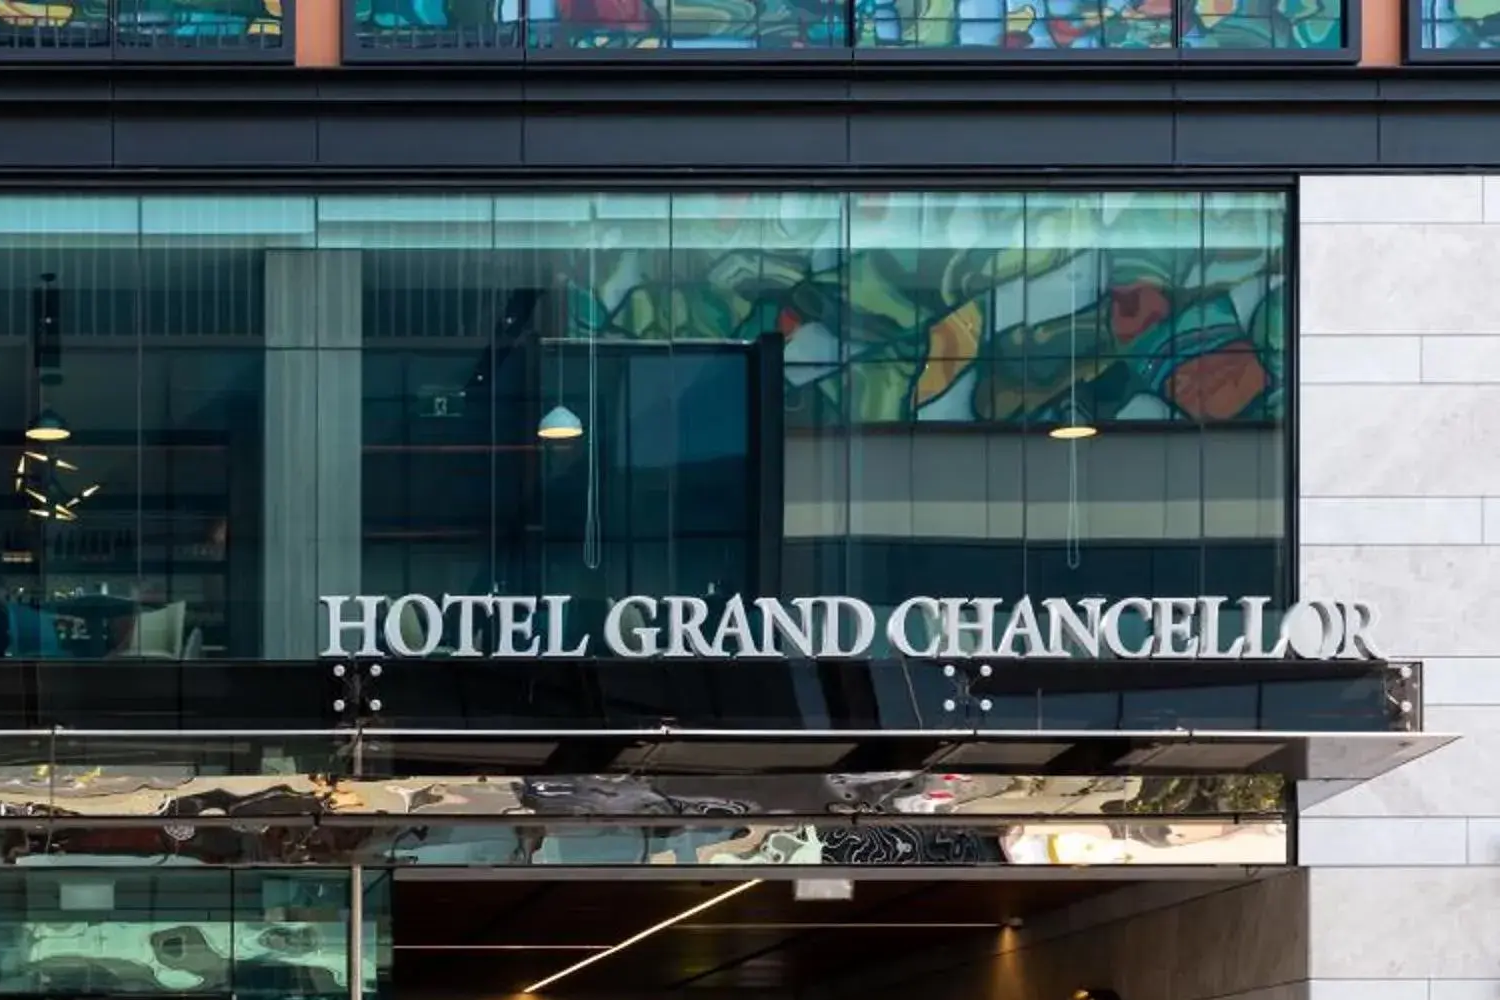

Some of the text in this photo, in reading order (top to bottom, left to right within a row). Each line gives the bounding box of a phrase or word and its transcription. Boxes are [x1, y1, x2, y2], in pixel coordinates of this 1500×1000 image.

[318, 593, 1389, 660] HOTEL GRAND CHANCELLOR
